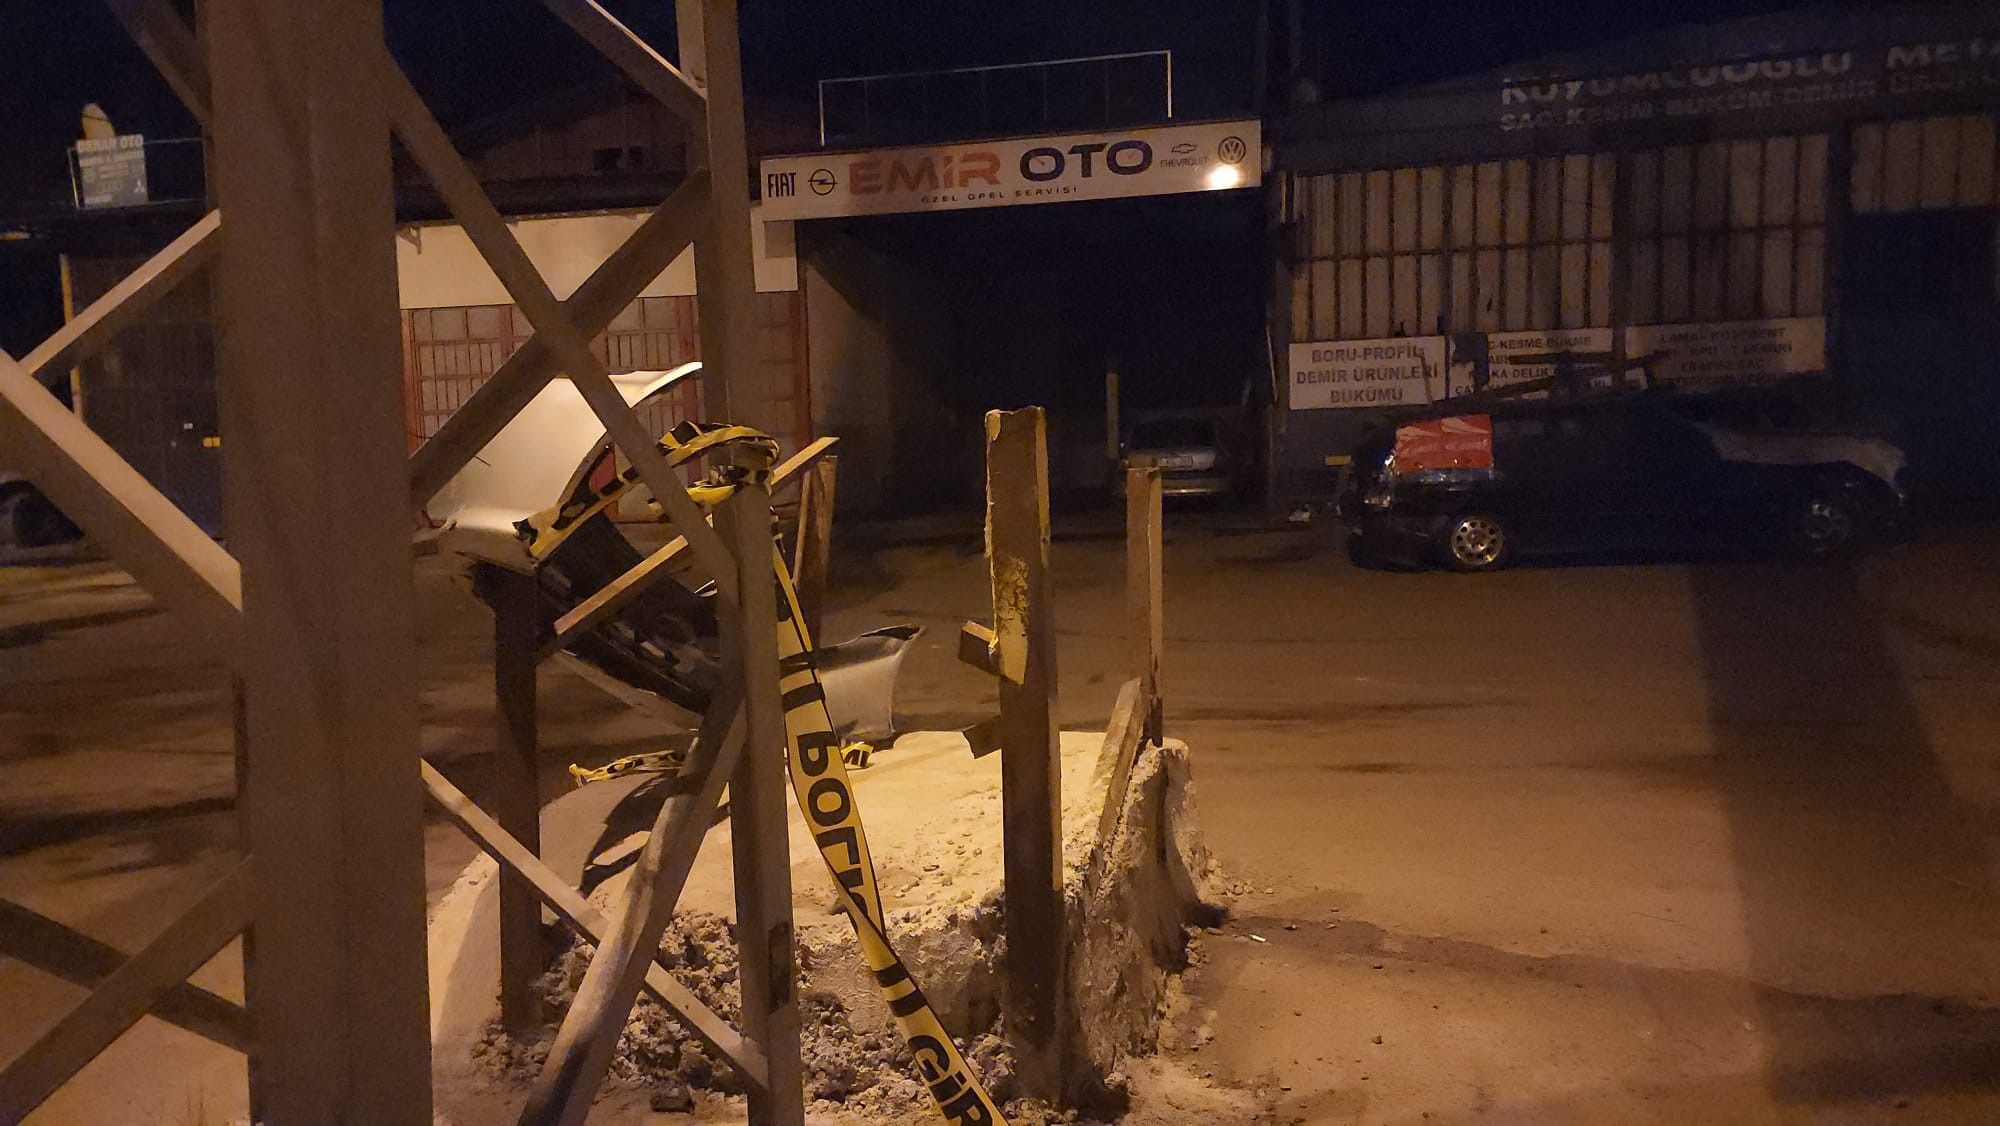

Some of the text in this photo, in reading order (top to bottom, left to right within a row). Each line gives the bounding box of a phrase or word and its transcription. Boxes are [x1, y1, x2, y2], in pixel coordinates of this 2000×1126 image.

[1019, 140, 1153, 183] OTO
[767, 172, 797, 198] FIAT
[968, 190, 1005, 201] OPEL
[1296, 369, 1348, 385] DEMİR
